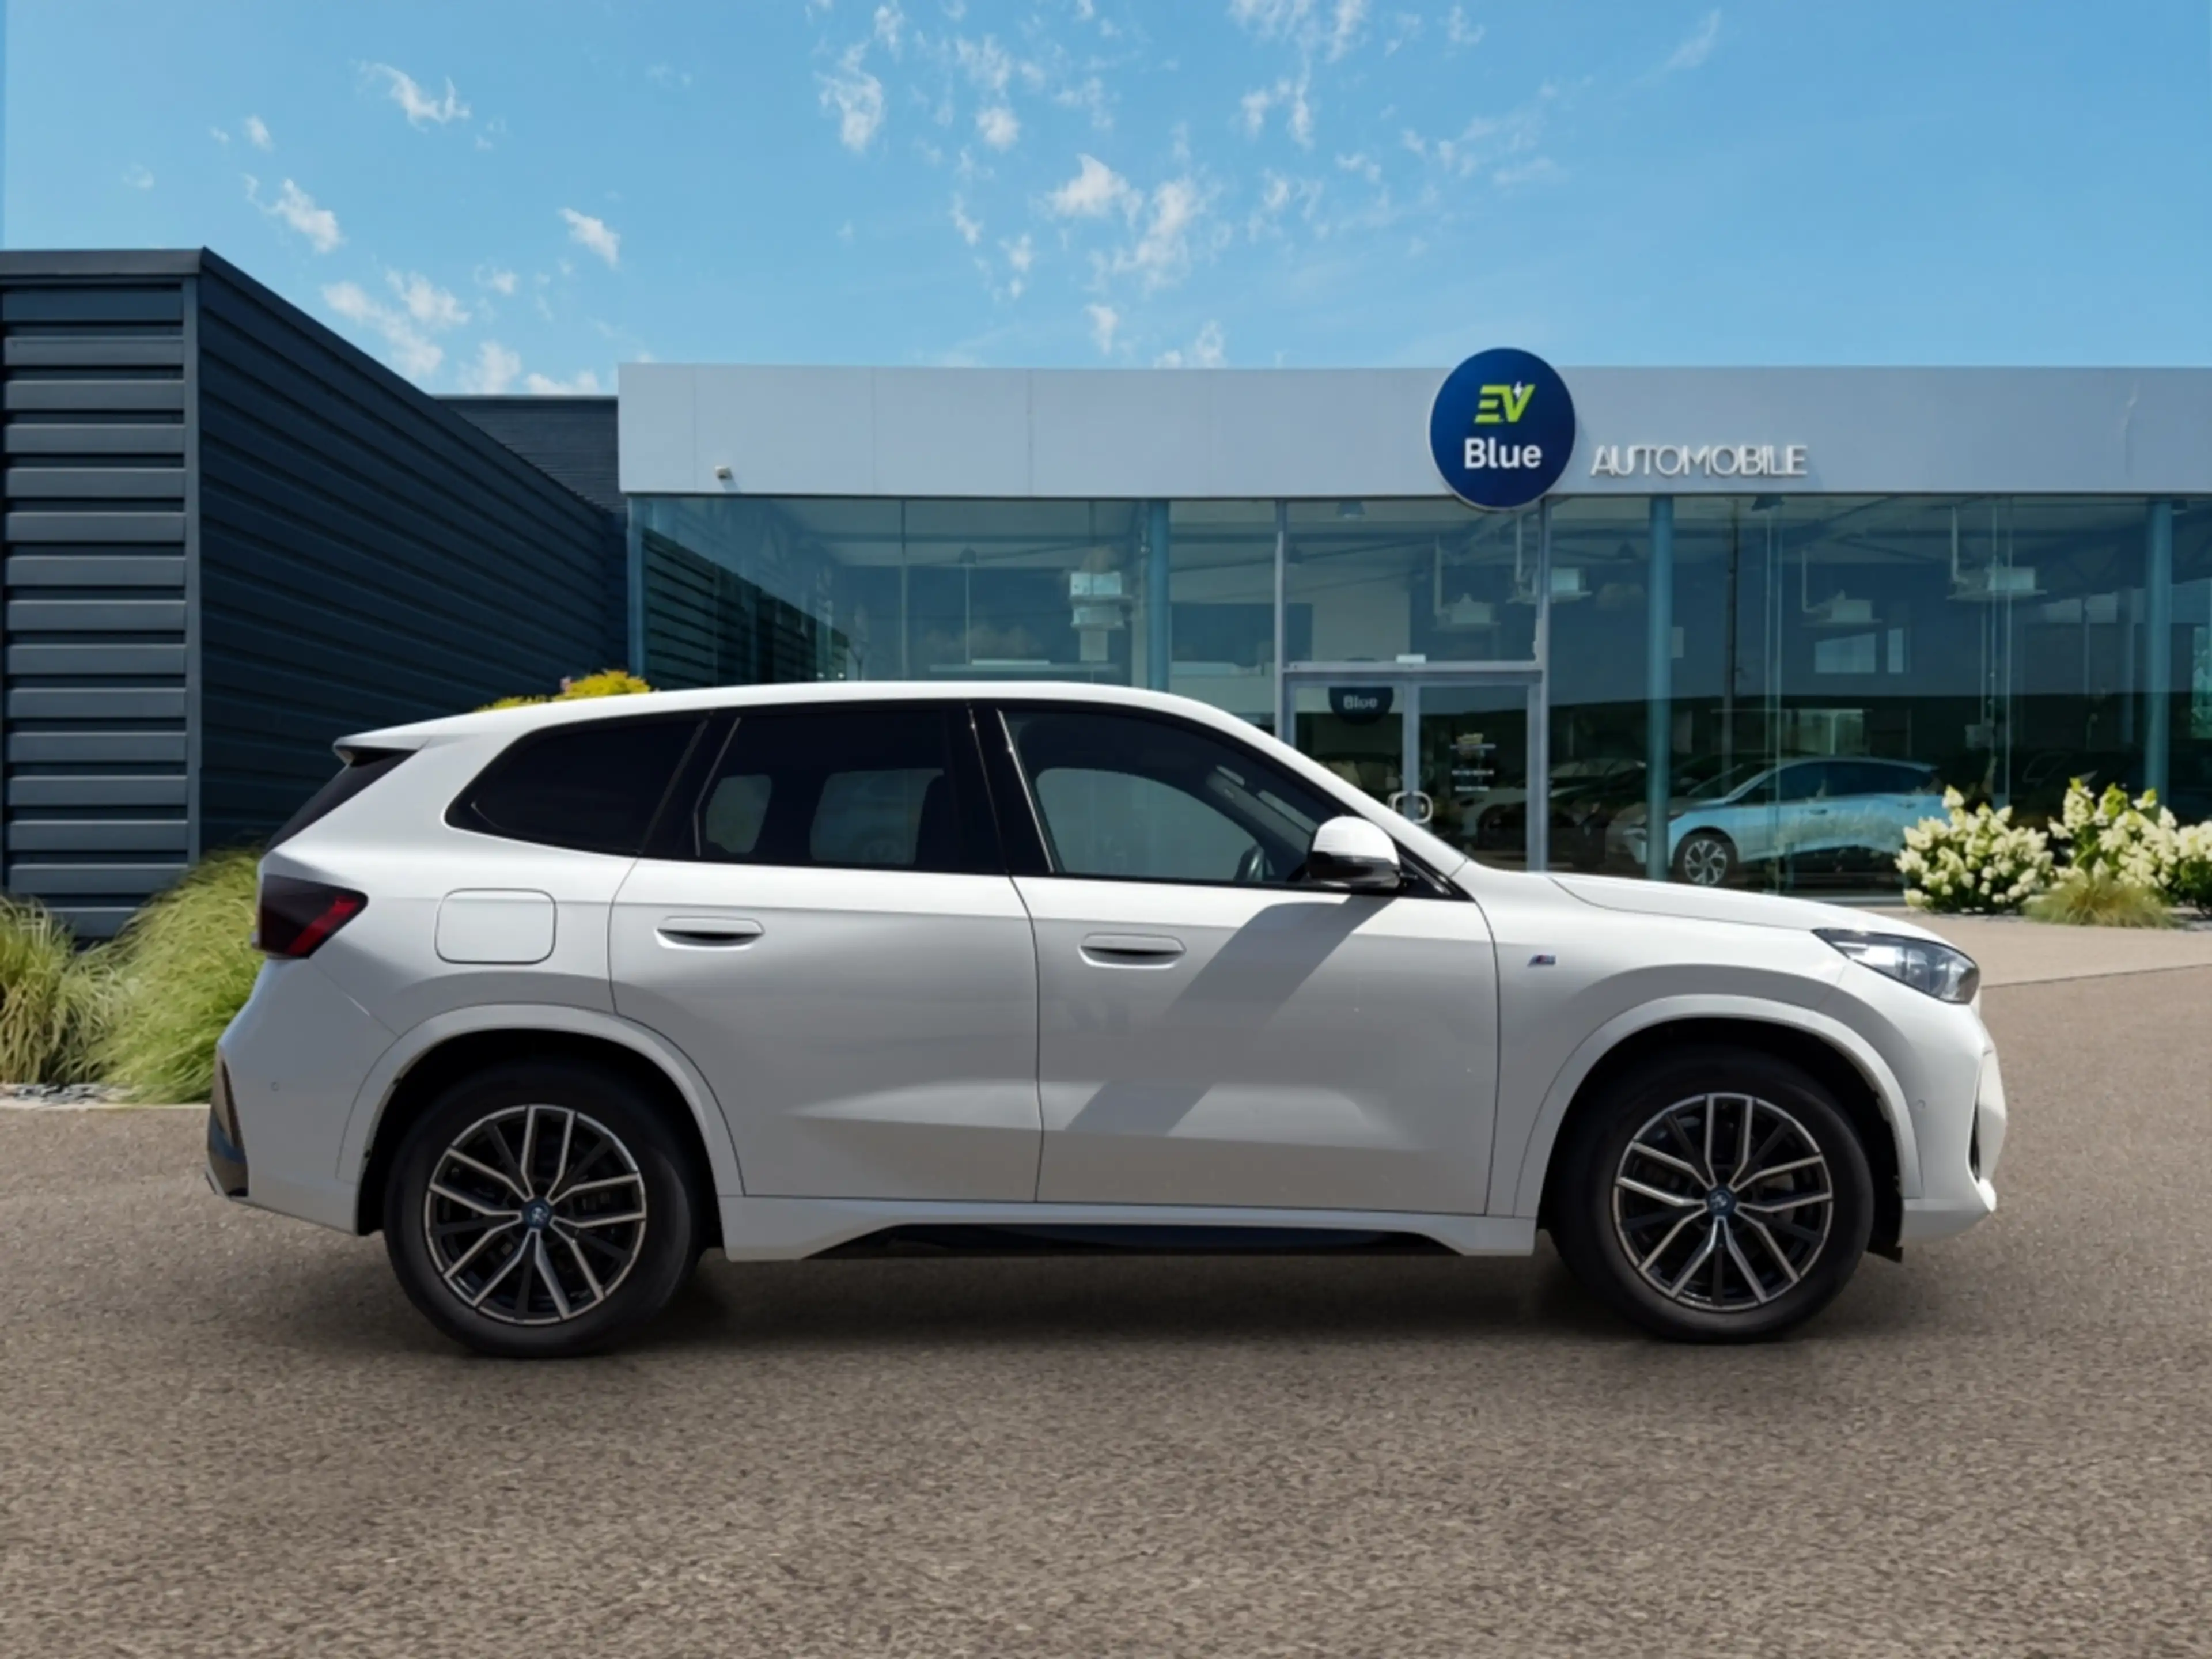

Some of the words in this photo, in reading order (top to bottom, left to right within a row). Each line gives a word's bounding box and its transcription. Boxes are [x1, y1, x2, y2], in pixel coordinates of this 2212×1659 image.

[1474, 382, 1536, 423] EV
[1464, 436, 1543, 469] Blue
[1590, 444, 1808, 476] AUTOMOBILE
